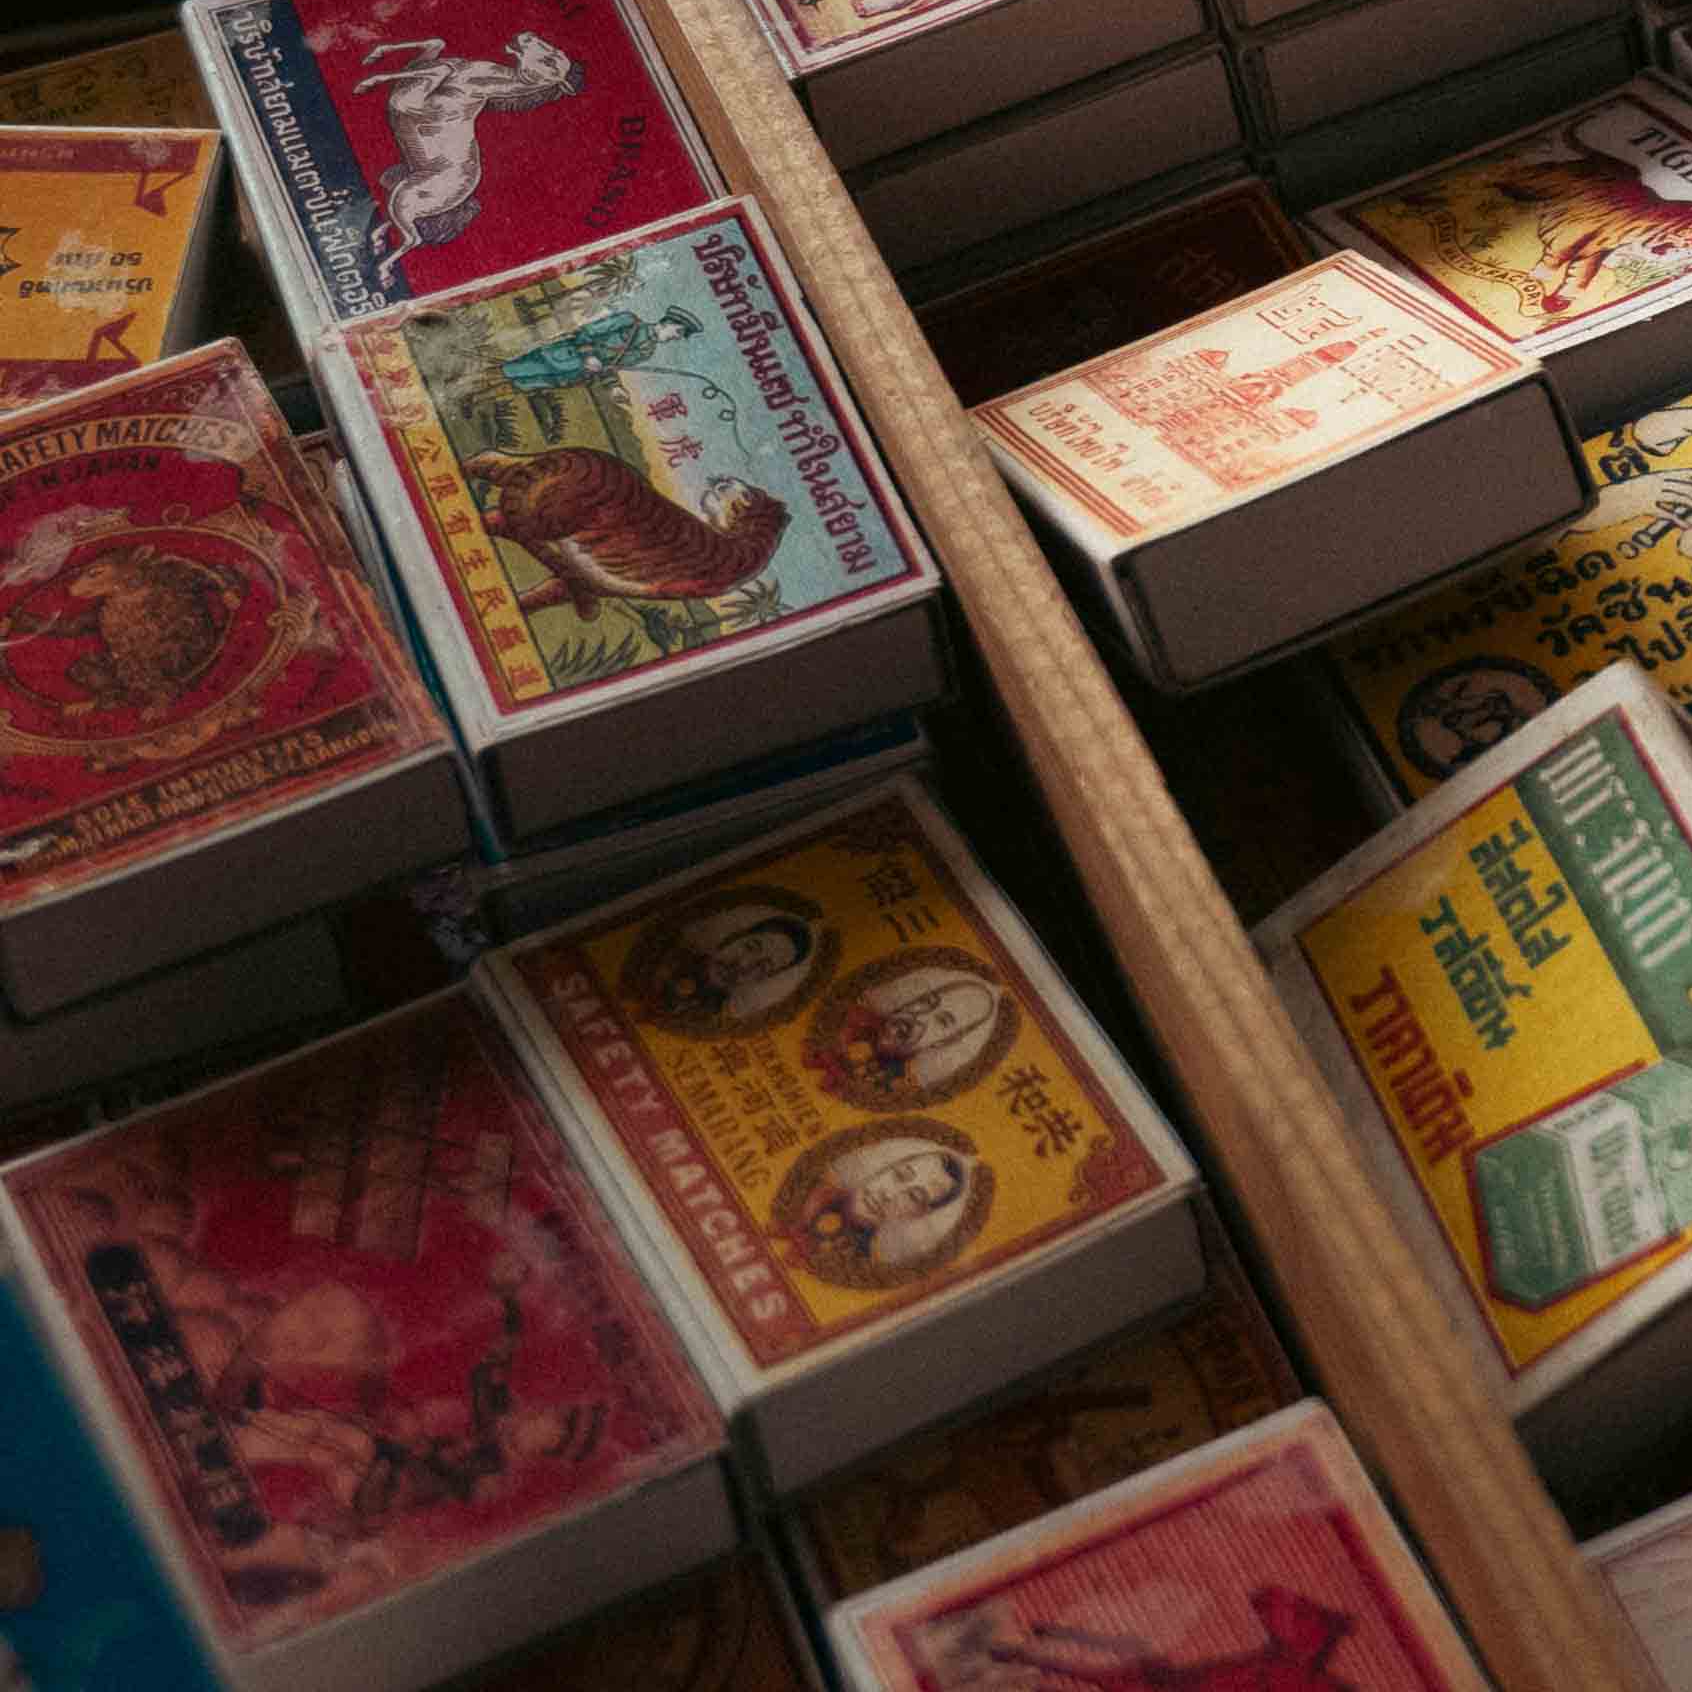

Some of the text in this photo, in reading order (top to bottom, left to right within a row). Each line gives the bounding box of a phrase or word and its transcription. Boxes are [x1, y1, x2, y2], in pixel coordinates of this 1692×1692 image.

[1485, 254, 1547, 311] FACTORY
[1461, 814, 1590, 969] สีสดใส
[547, 965, 793, 1329] SAFETY MATCHES
